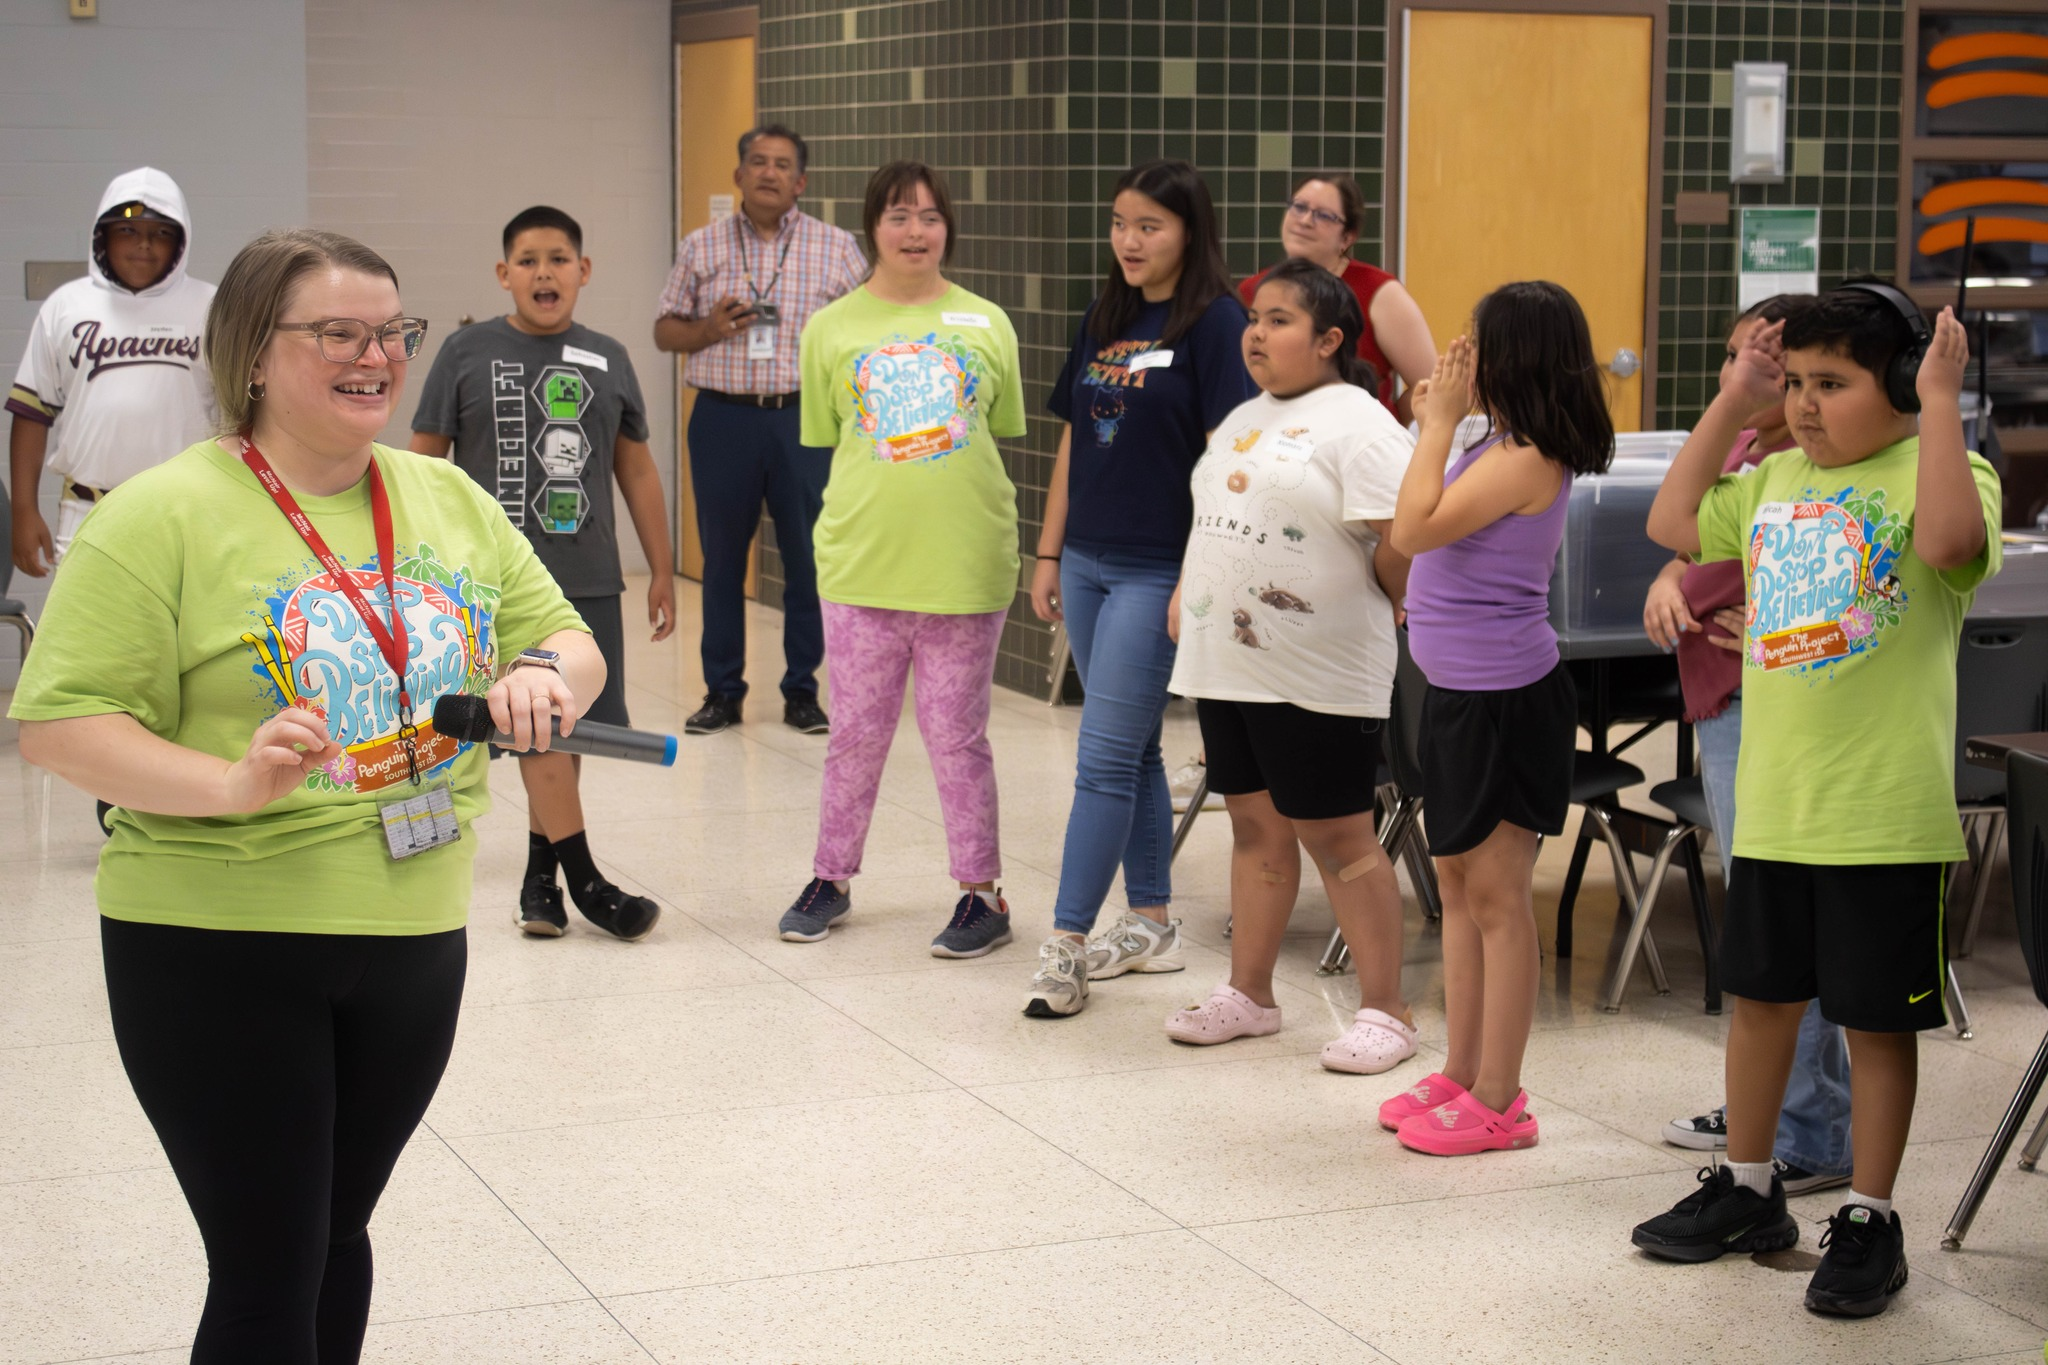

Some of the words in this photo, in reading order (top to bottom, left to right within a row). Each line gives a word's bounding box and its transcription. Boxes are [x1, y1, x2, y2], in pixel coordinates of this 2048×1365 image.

[259, 469, 272, 485] Level
[290, 512, 302, 528] Level
[1765, 641, 1799, 660] Penguin
[1800, 631, 1840, 651] Project
[1789, 632, 1809, 643] The
[358, 750, 408, 778] Penguin
[427, 754, 437, 765] ISD
